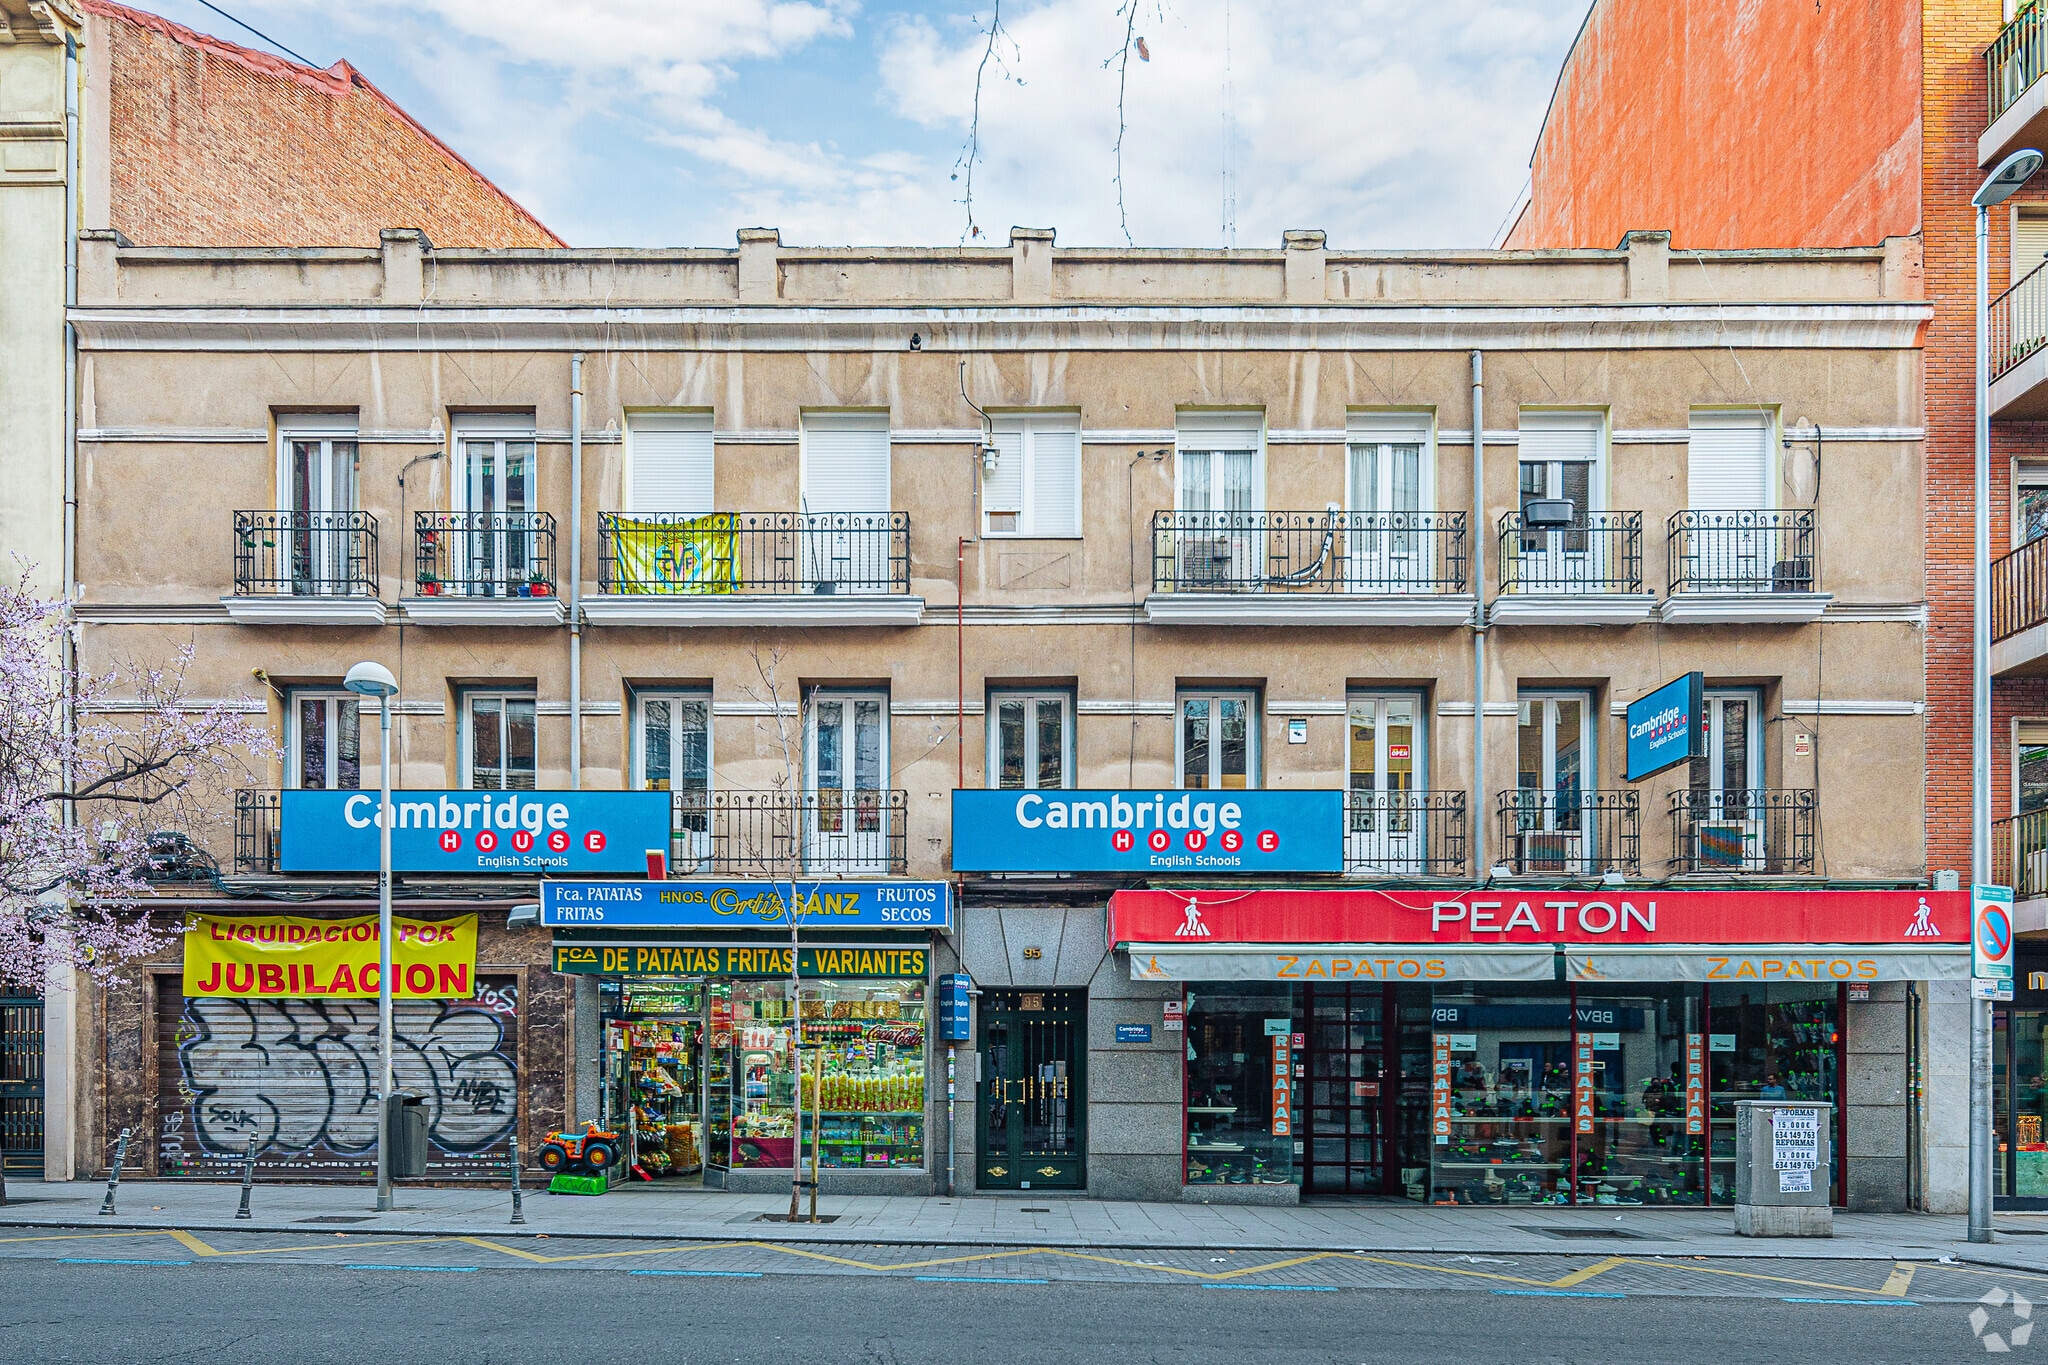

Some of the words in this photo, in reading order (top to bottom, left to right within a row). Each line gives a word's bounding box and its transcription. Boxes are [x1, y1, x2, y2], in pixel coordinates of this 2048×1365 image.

[1630, 706, 1679, 739] Cambridge
[1651, 715, 1687, 739] HOUSE
[1649, 736, 1668, 750] English
[1668, 727, 1687, 742] Schools
[344, 794, 569, 837] Cambridge
[1015, 793, 1241, 837] Cambridge
[444, 835, 601, 849] HOUSE
[1117, 834, 1274, 849] HOUSE
[477, 855, 520, 868] English
[523, 855, 568, 866] Schools
[1149, 855, 1191, 867] English
[1195, 855, 1241, 866] Schools
[556, 887, 583, 901] Fca.
[587, 887, 643, 901] PATATAS
[660, 891, 708, 904] HNOS.
[789, 893, 860, 915] SANZ
[877, 888, 937, 902] FRUTOS
[557, 907, 604, 921] FRITAS
[881, 908, 932, 922] SECOS
[1433, 902, 1656, 933] PEATON
[399, 923, 456, 943] POR
[603, 948, 629, 971] DE
[637, 948, 720, 972] PATATAS
[727, 948, 794, 973] FRITAS
[815, 950, 924, 975] VARIANTES
[1024, 948, 1041, 959] 95
[197, 962, 467, 994] JUBILACION
[1276, 956, 1447, 979] ZAPATOS
[1706, 957, 1878, 979] ZAPATOS
[1025, 996, 1040, 1008] 95
[1274, 1035, 1288, 1133] REBAJAS
[1435, 1035, 1449, 1132] REBAJAS
[1578, 1034, 1593, 1131] REBAJAS
[1688, 1034, 1703, 1132] REBAJAS
[1775, 1131, 1788, 1139] 634
[1790, 1131, 1801, 1139] 149
[1803, 1131, 1815, 1139] 763
